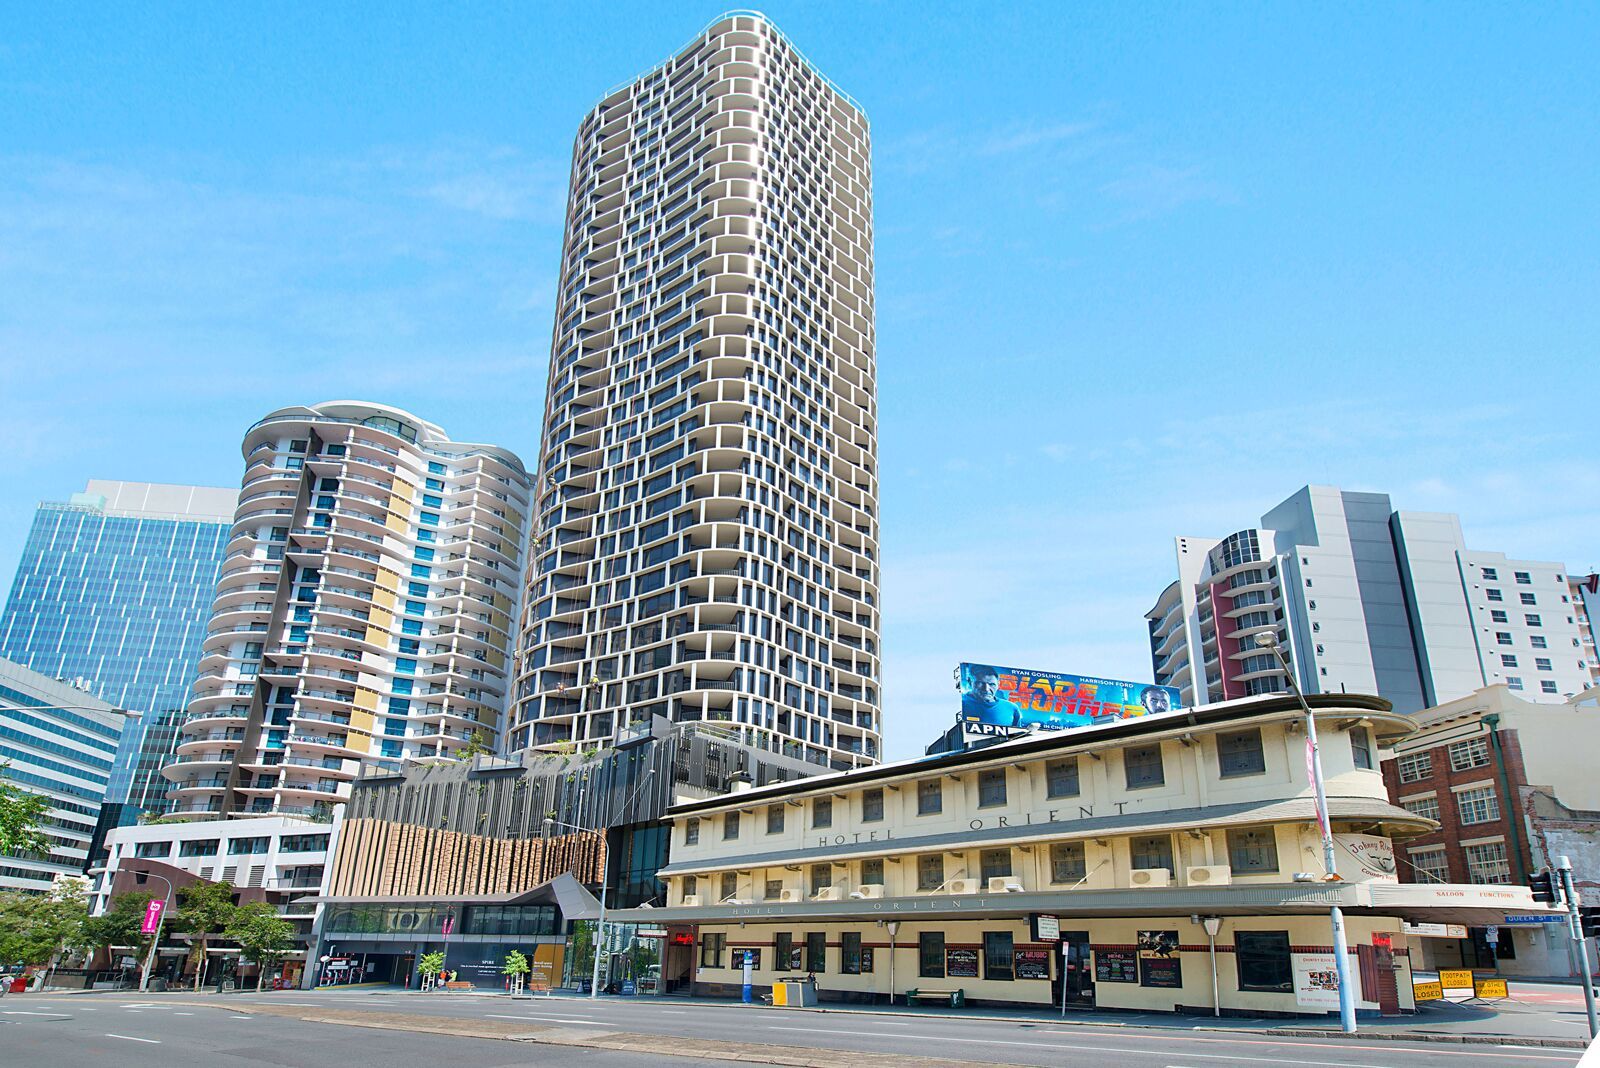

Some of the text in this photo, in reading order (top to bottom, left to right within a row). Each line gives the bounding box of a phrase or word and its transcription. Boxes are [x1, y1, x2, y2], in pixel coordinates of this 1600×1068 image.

[1031, 671, 1062, 680] GOSLING
[998, 673, 1098, 700] BLADE
[1079, 677, 1135, 689] HARRISON FORD
[969, 723, 1007, 737] APN
[819, 801, 1129, 847] HOTEL ORIENT
[732, 899, 985, 915] HOTEL ORIENT
[1446, 979, 1468, 987] CLOSED
